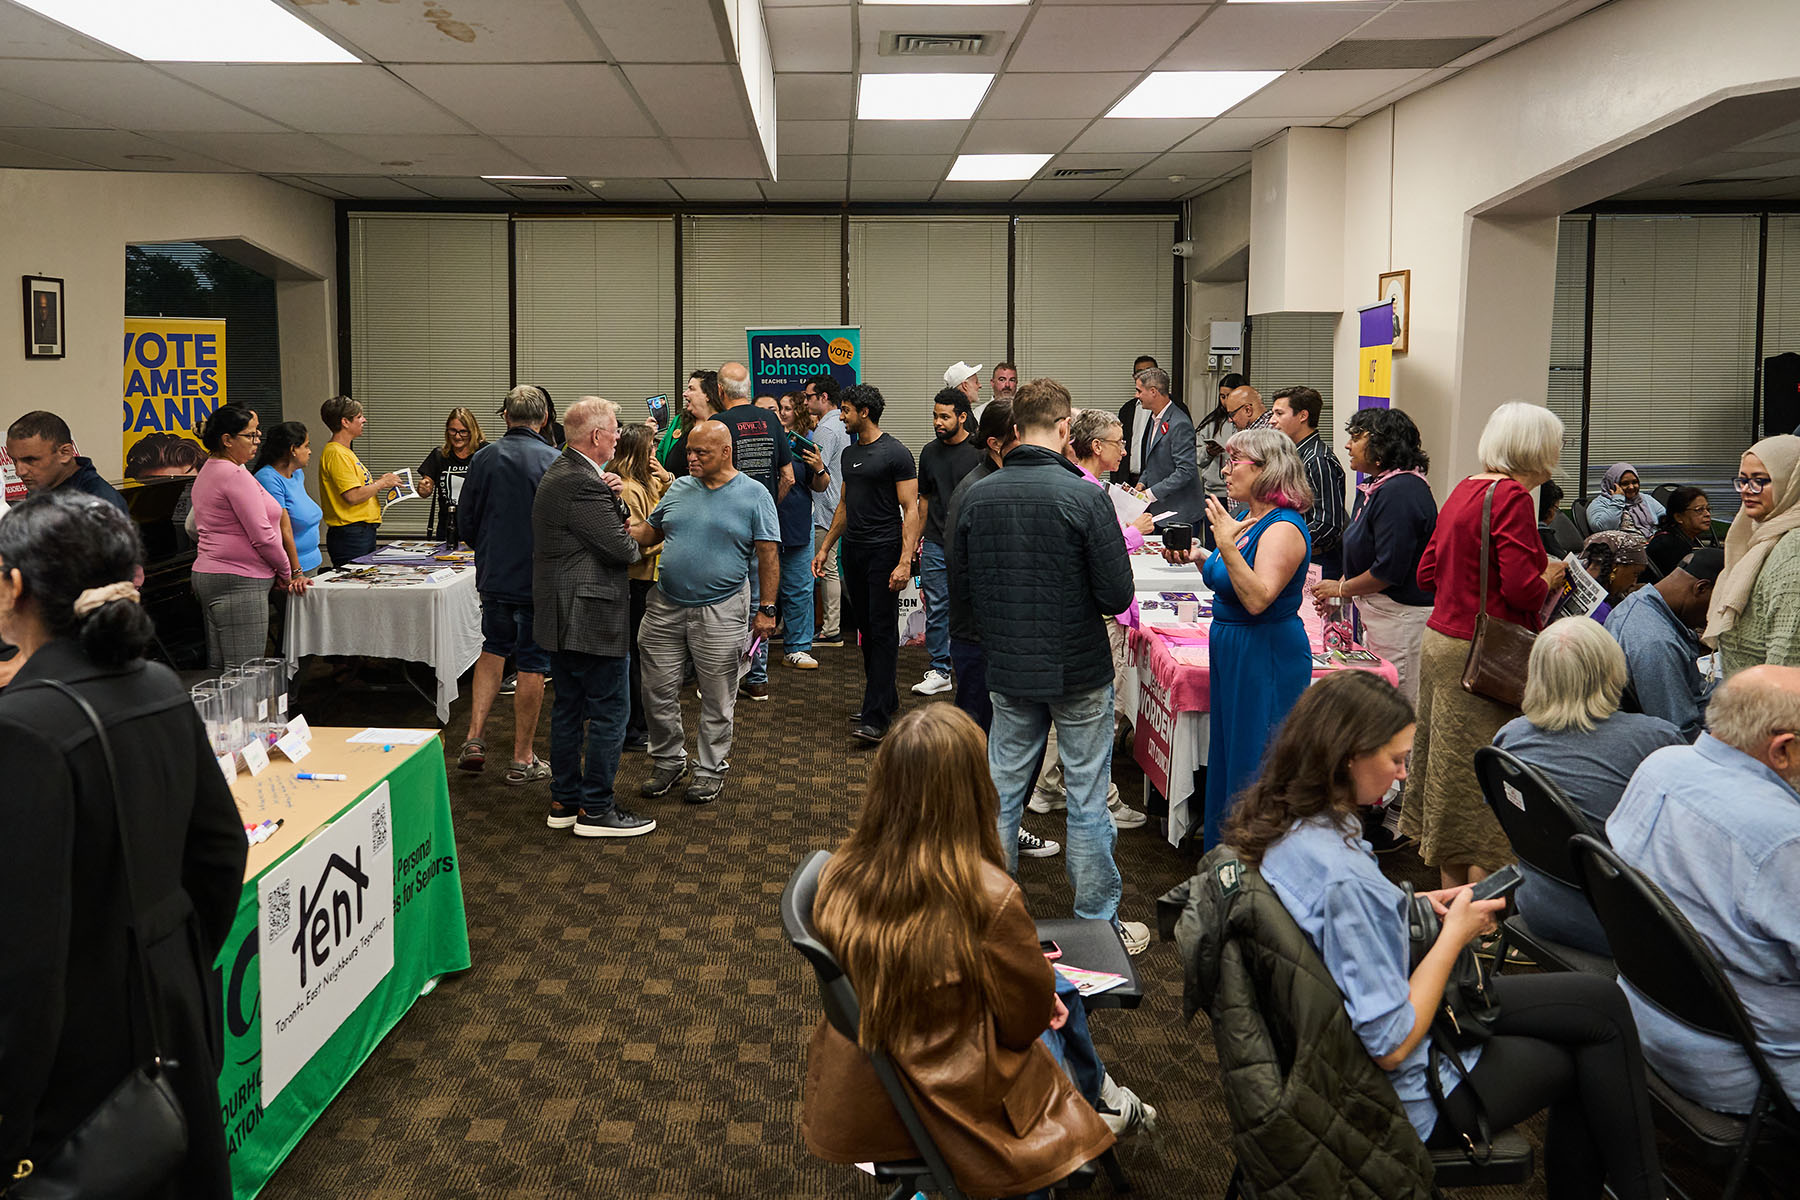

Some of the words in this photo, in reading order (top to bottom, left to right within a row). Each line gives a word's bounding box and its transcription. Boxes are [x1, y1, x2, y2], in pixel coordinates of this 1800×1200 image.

[760, 342, 822, 359] Natalie
[829, 345, 853, 360] VOTE
[757, 360, 831, 376] Johnson
[124, 368, 219, 398] AMES
[1140, 687, 1173, 745] WORDEN
[397, 832, 432, 882] Personal
[402, 881, 415, 907] for
[275, 1001, 304, 1035] Toronto
[306, 982, 322, 1006] East
